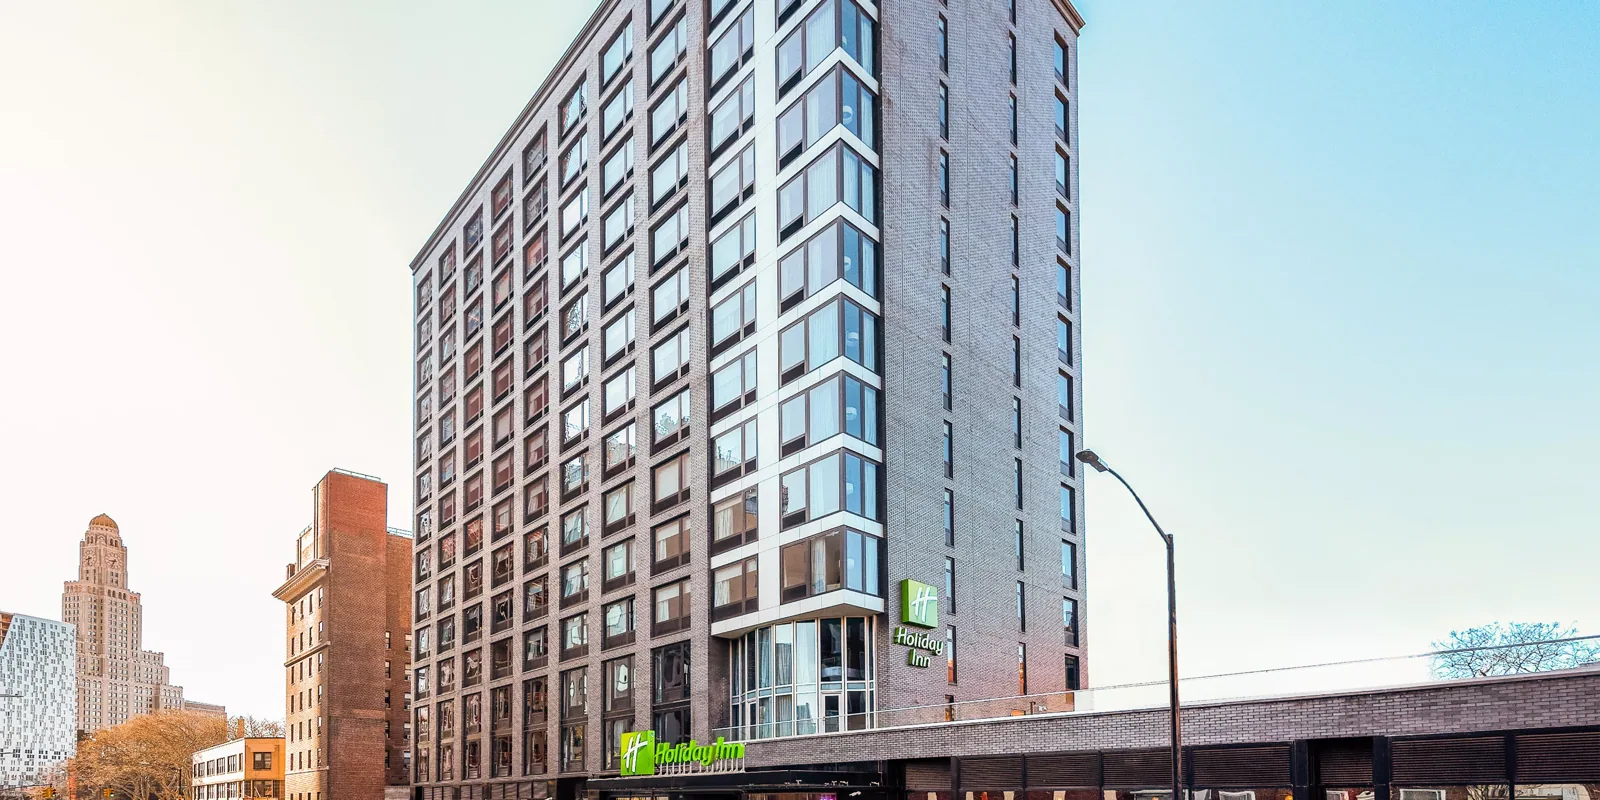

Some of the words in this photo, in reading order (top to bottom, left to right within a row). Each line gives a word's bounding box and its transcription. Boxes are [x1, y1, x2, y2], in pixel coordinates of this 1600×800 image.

[911, 586, 938, 623] H
[896, 626, 944, 656] Holiday
[910, 648, 931, 668] Inn
[623, 733, 648, 773] H
[655, 739, 714, 767] Holiday
[715, 736, 745, 760] Inn
